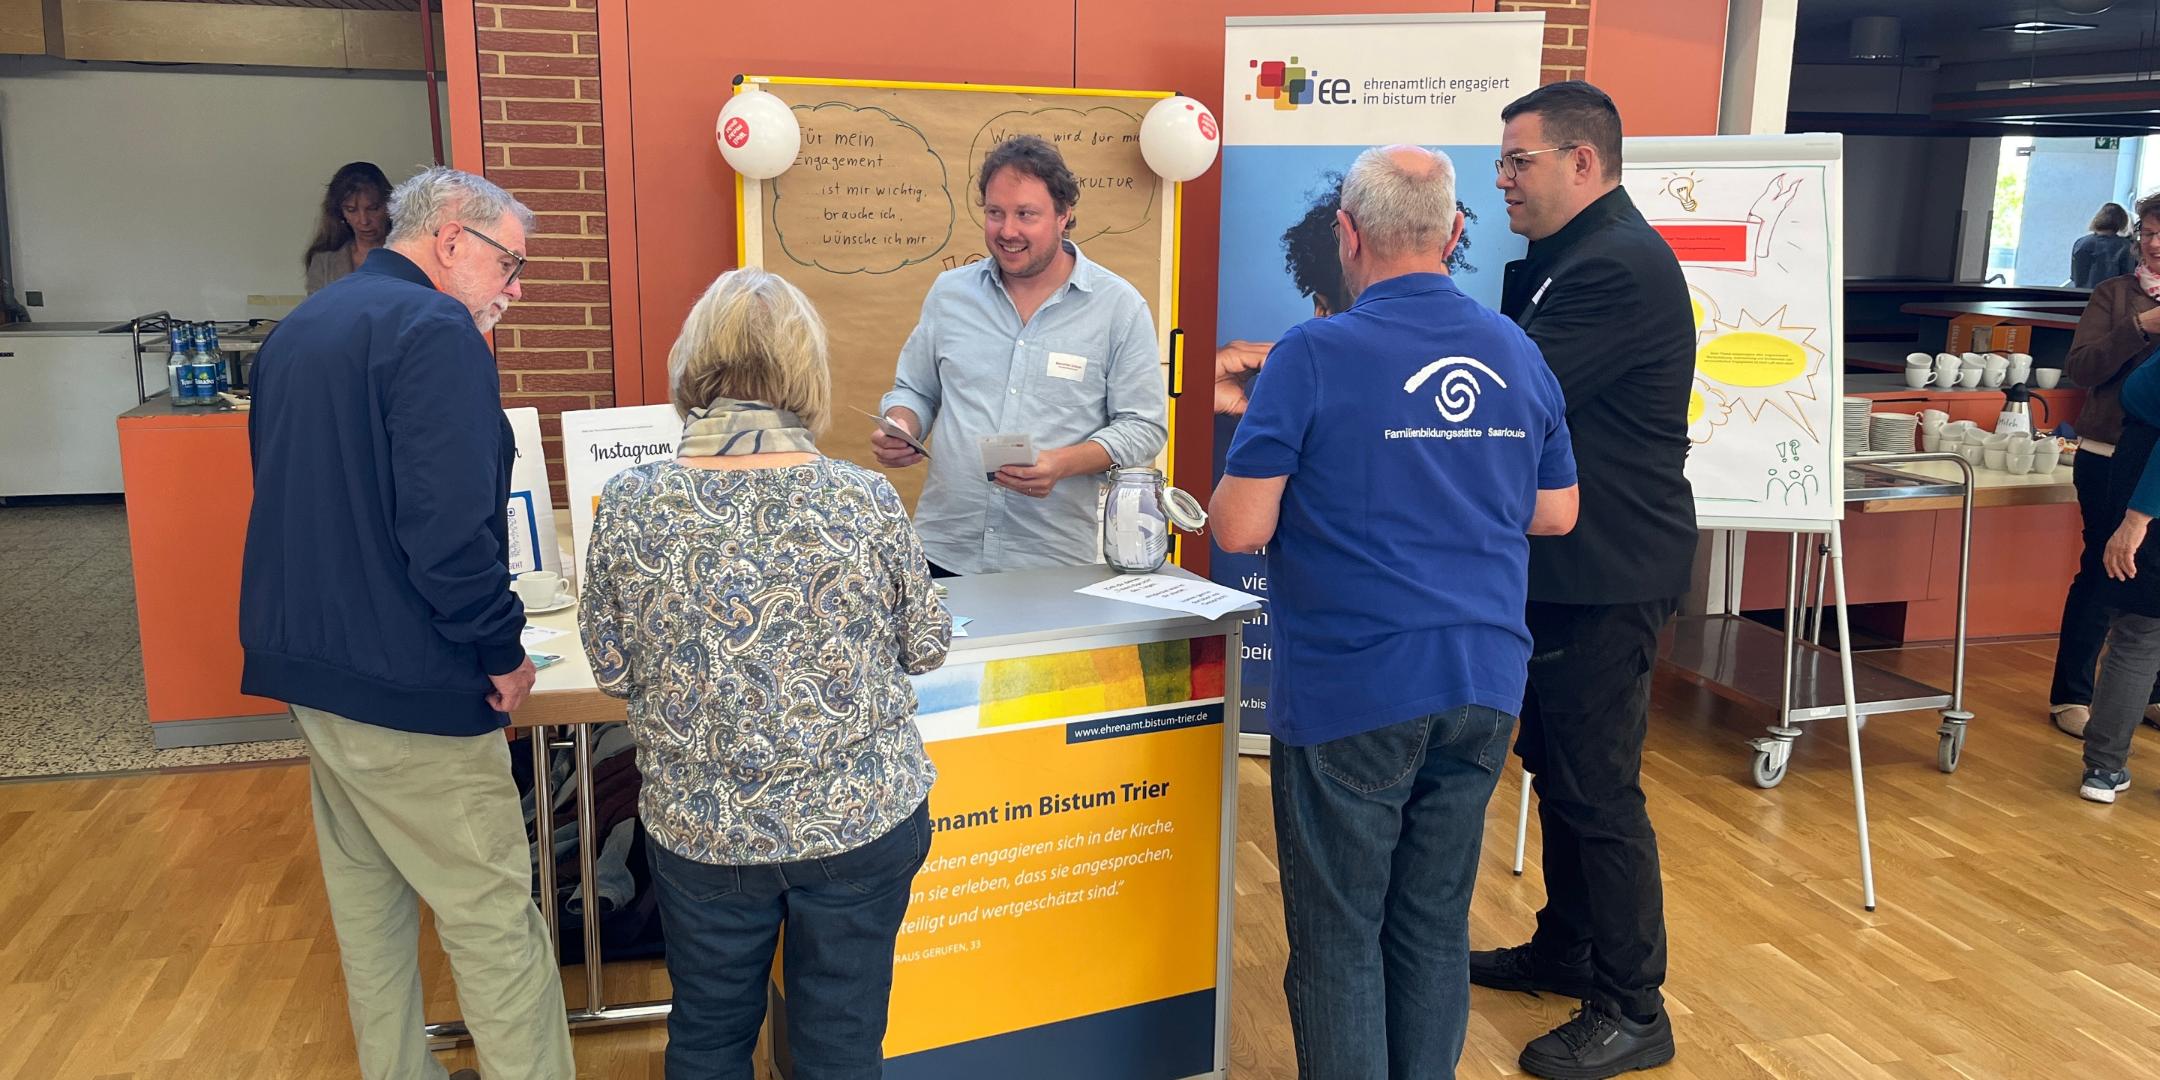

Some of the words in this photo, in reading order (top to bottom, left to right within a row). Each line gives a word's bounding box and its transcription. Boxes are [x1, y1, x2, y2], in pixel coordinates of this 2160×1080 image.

[1363, 77, 1446, 91] ehrenamtlich
[1450, 77, 1510, 93] engagiert
[1363, 93, 1379, 105] im
[1382, 92, 1427, 105] bistum
[1430, 92, 1457, 105] trier
[835, 132, 874, 147] mein
[1053, 130, 1082, 143] wird
[822, 181, 840, 195] ist
[847, 186, 870, 196] mir
[824, 207, 874, 221] brauche
[823, 229, 878, 245] wünsche
[884, 232, 902, 245] ich
[906, 234, 928, 245] mir
[1385, 427, 1482, 440] Familienbildungsstätte
[1488, 427, 1526, 439] Saarlouis
[590, 441, 673, 464] Instagram
[1074, 711, 1208, 738] www.ehrenamt.bistum-trier.de
[1005, 802, 1032, 821] im
[1039, 790, 1116, 816] Bistum
[1120, 780, 1170, 802] Trier
[970, 840, 1053, 867] engagieren
[1056, 833, 1085, 851] sich
[1087, 831, 1101, 845] in
[1104, 827, 1128, 843] der
[1130, 818, 1175, 838] Kirche,
[928, 884, 949, 901] sie
[952, 877, 1010, 897] erleben,
[1014, 867, 1047, 887] dass
[1050, 863, 1070, 880] sie
[1072, 847, 1174, 877] angesprochen,
[948, 907, 978, 927] und
[981, 889, 1084, 918] wertgeschätzt
[922, 942, 969, 959] GERUFEN,
[970, 939, 982, 950] 33
